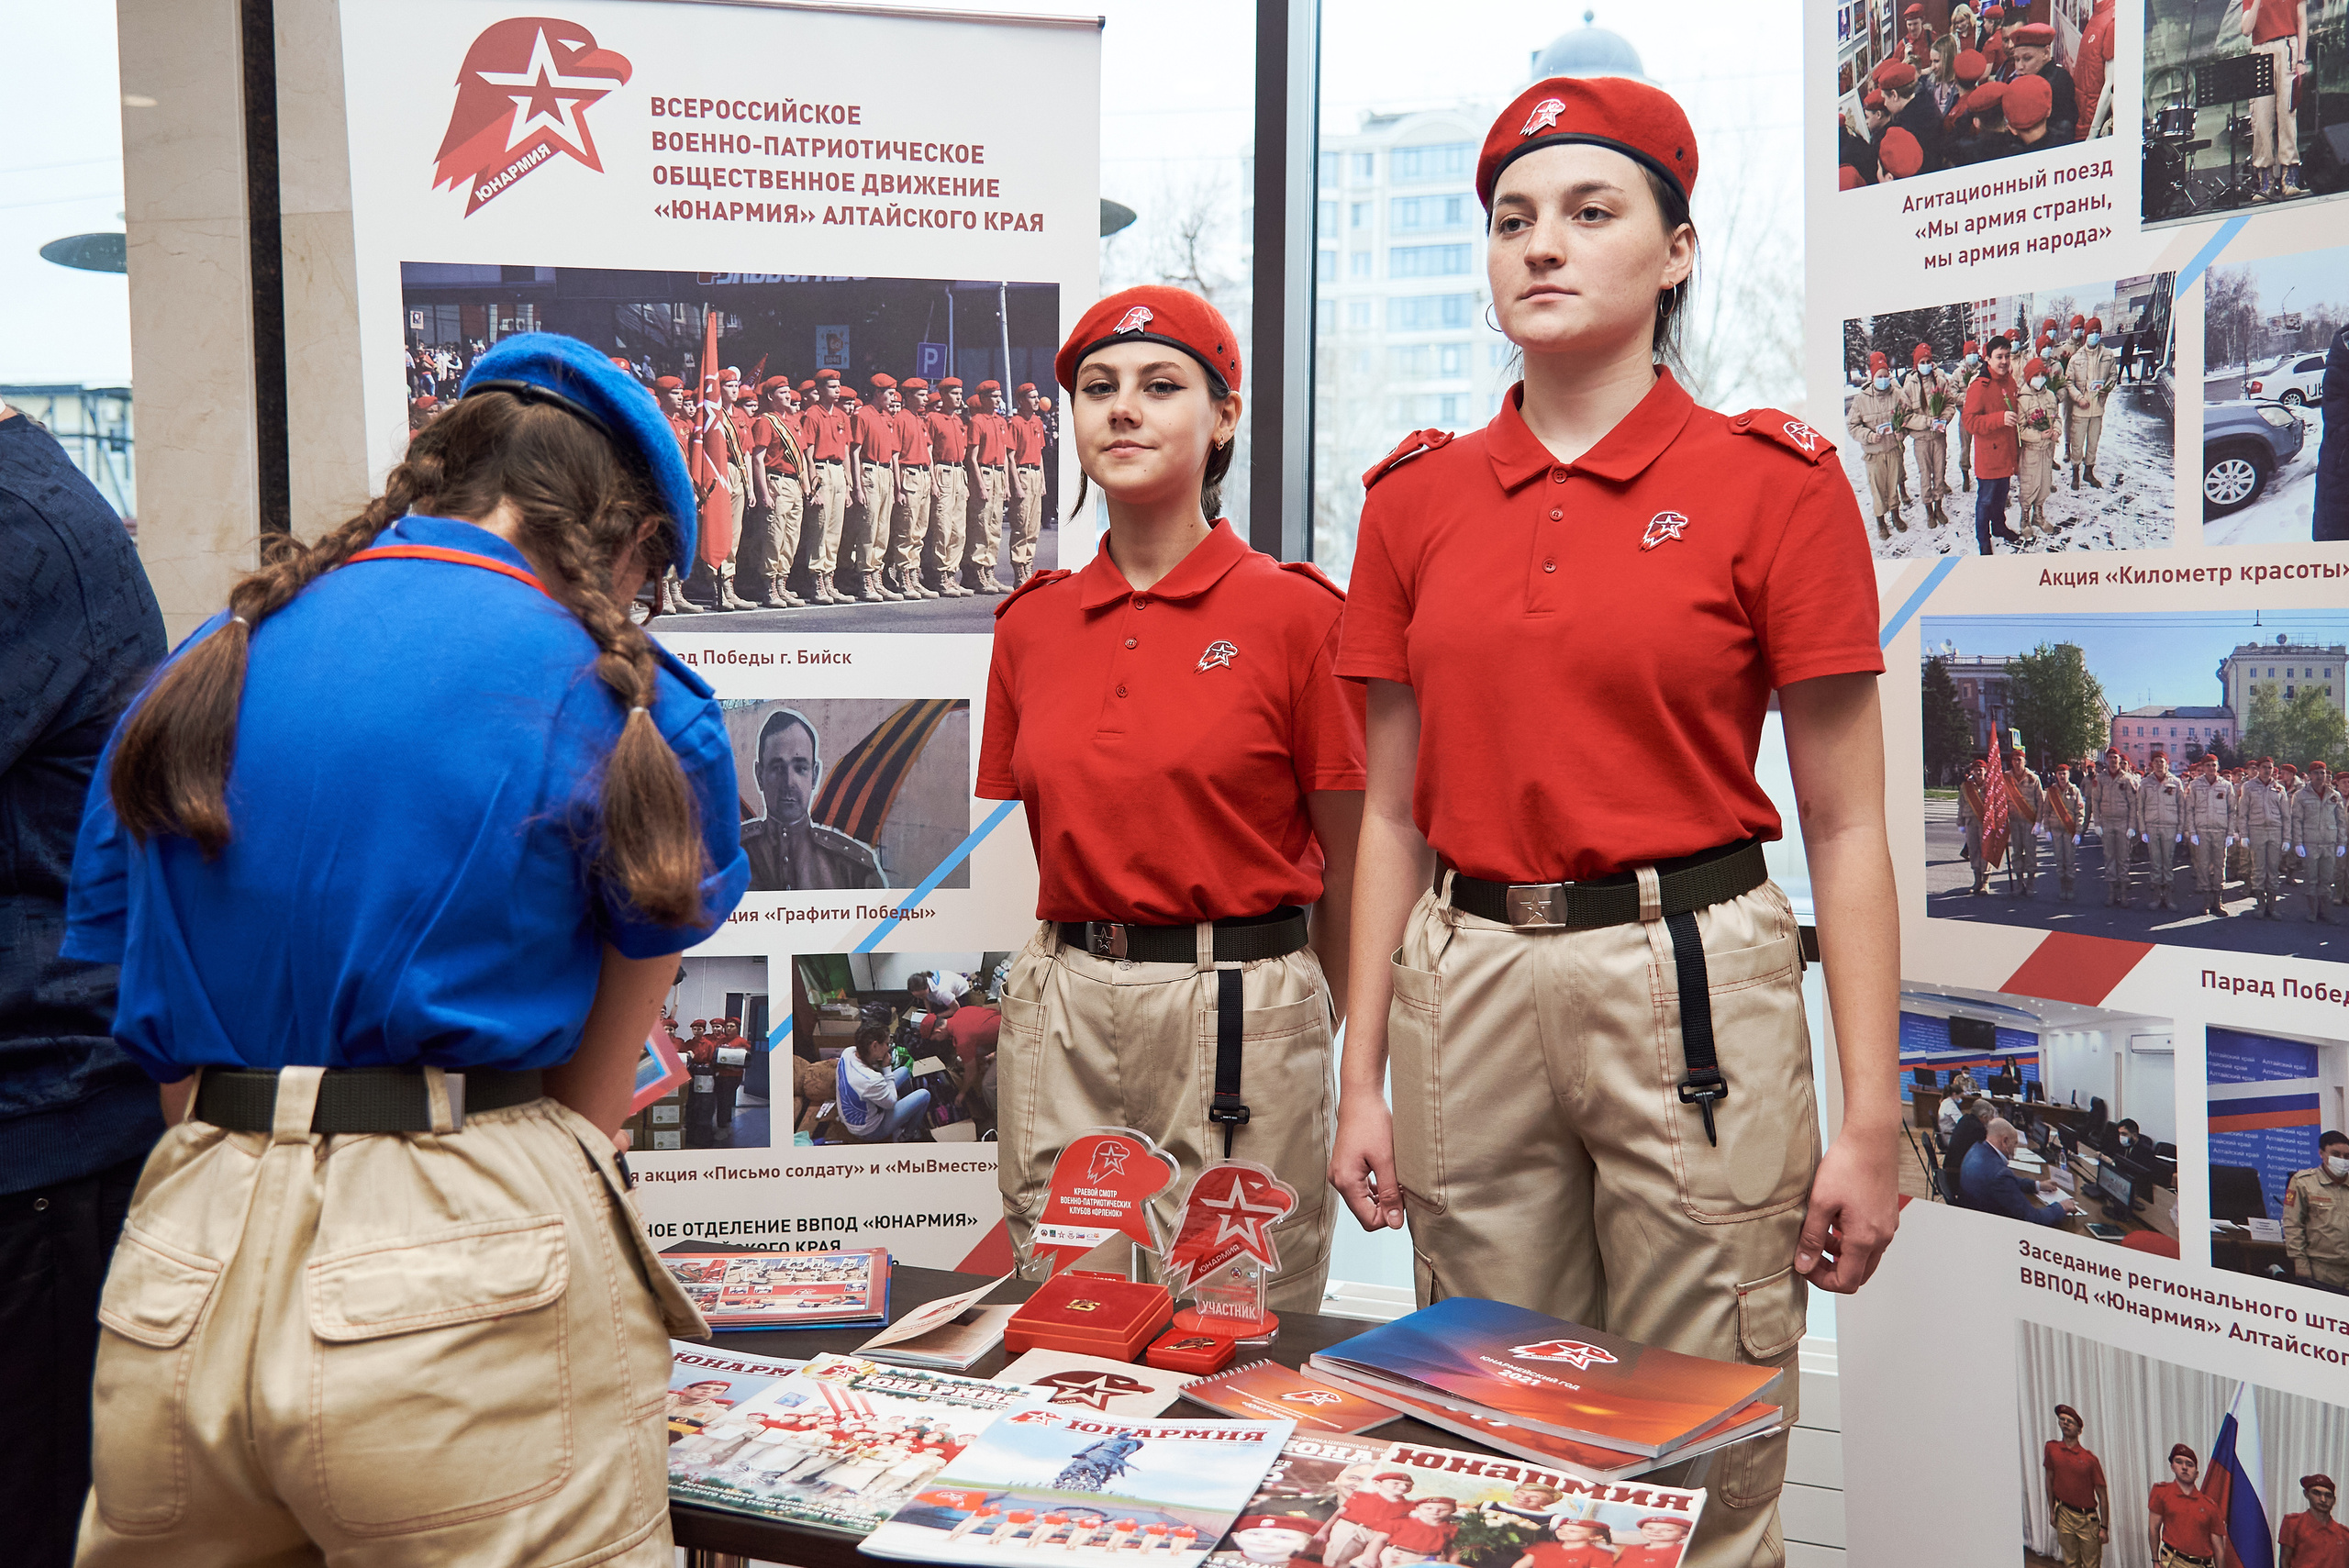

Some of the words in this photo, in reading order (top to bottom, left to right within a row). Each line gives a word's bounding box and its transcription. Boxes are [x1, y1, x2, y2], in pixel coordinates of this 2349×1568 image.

[651, 96, 861, 126] ВСЕРОССИЙСКОЕ
[651, 131, 985, 165] ВОЕННО-ПАТРИОТИЧЕСКОЕ
[475, 142, 551, 203] ЮНАРМИЯ
[652, 165, 856, 195] ОБЩЕСТВЕННОЕ
[862, 173, 1000, 199] ДВИЖЕНИЕ
[1901, 169, 2048, 215] Агитационный
[2053, 159, 2113, 189] поезд
[653, 200, 817, 226] «ЮНАРМИЯ»
[822, 201, 977, 232] АЛТАЙСКОГО
[984, 210, 1045, 234] КРАЯ
[1914, 210, 1958, 240] «Мы
[1964, 206, 2027, 235] армия
[2032, 192, 2112, 228] страны,
[1924, 246, 1953, 271] мы
[1957, 238, 2021, 266] армия
[2025, 224, 2111, 254] народа»
[2038, 567, 2099, 589] Акция
[2105, 562, 2232, 587] «Километр
[2240, 562, 2349, 583] красоты»
[703, 650, 774, 667] Победы
[780, 652, 792, 664] г.
[797, 649, 852, 665] Бийск
[726, 910, 759, 925] ция
[764, 906, 851, 925] «Графити
[856, 905, 936, 921] Победы»
[2201, 969, 2276, 999] Парад
[645, 1169, 697, 1184] акция
[702, 1166, 781, 1181] «Письмо
[785, 1164, 864, 1179] солдату»
[870, 1163, 880, 1174] и
[885, 1159, 998, 1173] «МыВместе»
[1060, 1196, 1131, 1208] ВОЕННО-ПАТРИОТИЧЕСКИХ
[1074, 1187, 1098, 1196] КРАЕВОЙ
[1099, 1189, 1117, 1197] СМОТР
[683, 1218, 791, 1238] ОТДЕЛЕНИЕ
[796, 1216, 858, 1233] ВВПОД
[863, 1213, 978, 1229] «ЮНАРМИЯ»
[1069, 1207, 1091, 1216] КЛУБОВ
[796, 1240, 841, 1251] КРАЯ
[1197, 1243, 1240, 1273] ЮНАРМИЯ
[2018, 1239, 2122, 1283] Заседание
[2127, 1269, 2298, 1323] регионального
[2305, 1312, 2349, 1336] шта
[1202, 1300, 1256, 1319] УЧАСТНИК
[2020, 1266, 2088, 1305] ВВПОД
[2093, 1291, 2221, 1334] «Юнармия»
[2228, 1321, 2349, 1366] Алтайског
[1479, 1355, 1558, 1384] ЮНАРМЕЙСКИЙ
[1559, 1380, 1580, 1391] ГОД
[1497, 1369, 1542, 1386] 2021
[1064, 1420, 1268, 1441] ЮНАРМИЯ
